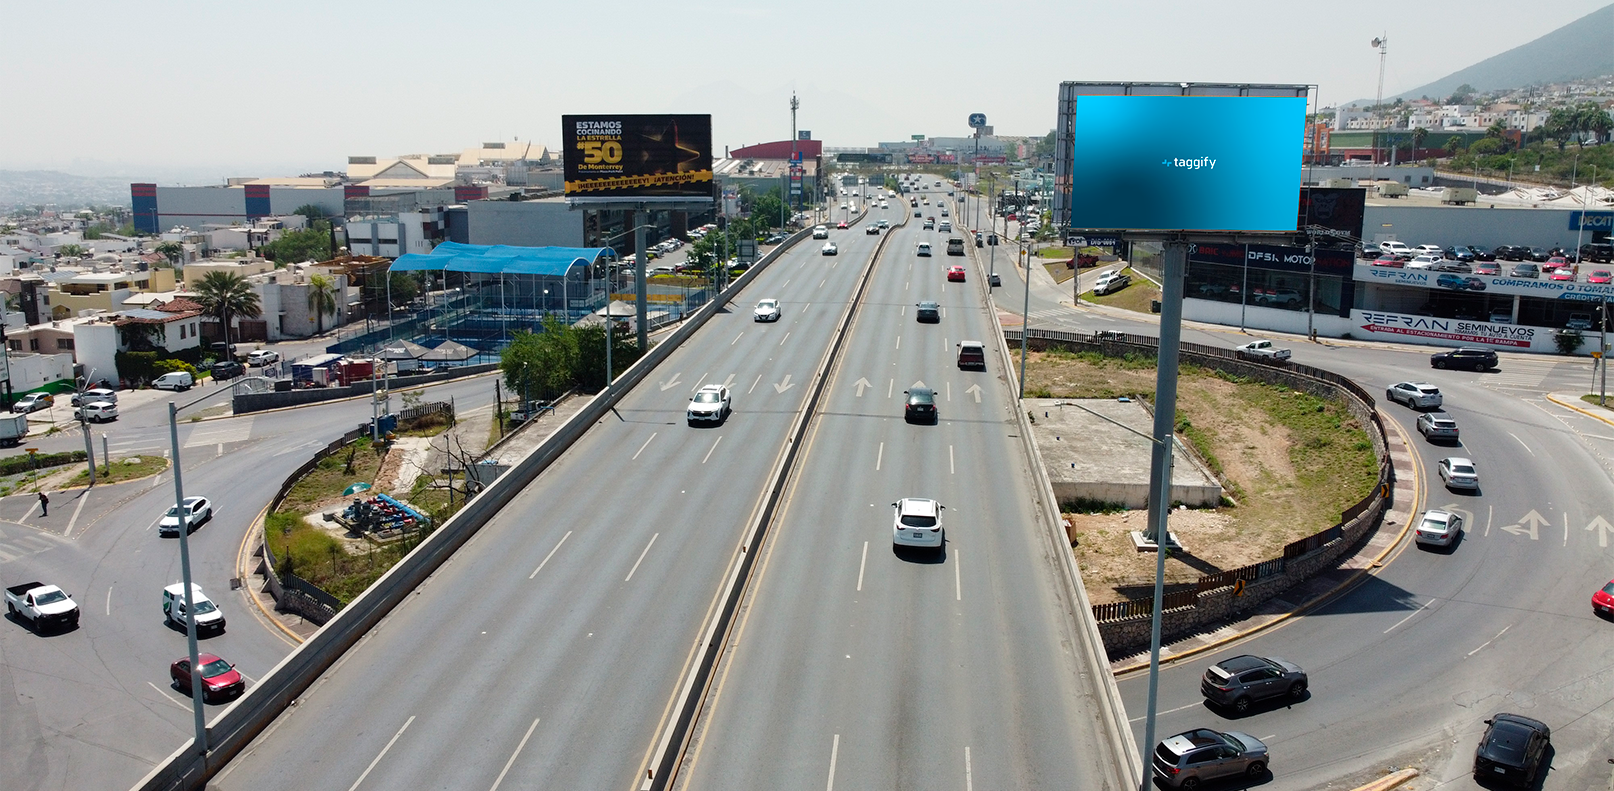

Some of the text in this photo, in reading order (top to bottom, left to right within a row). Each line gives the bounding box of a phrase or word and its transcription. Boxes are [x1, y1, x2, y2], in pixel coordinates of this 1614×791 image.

[576, 121, 622, 129] ESTAMOS
[576, 141, 623, 164] #50
[588, 164, 623, 172] Monterrey
[1174, 156, 1217, 170] taggify
[1369, 269, 1428, 281] REFRAN
[1492, 278, 1564, 290] COMPRAMOS
[1361, 312, 1449, 331] REFRAN
[1370, 325, 1395, 333] ENTRADA
[1406, 329, 1460, 340] ESTACIONAMIENTO
[1457, 322, 1535, 337] SEMINUEVOS
